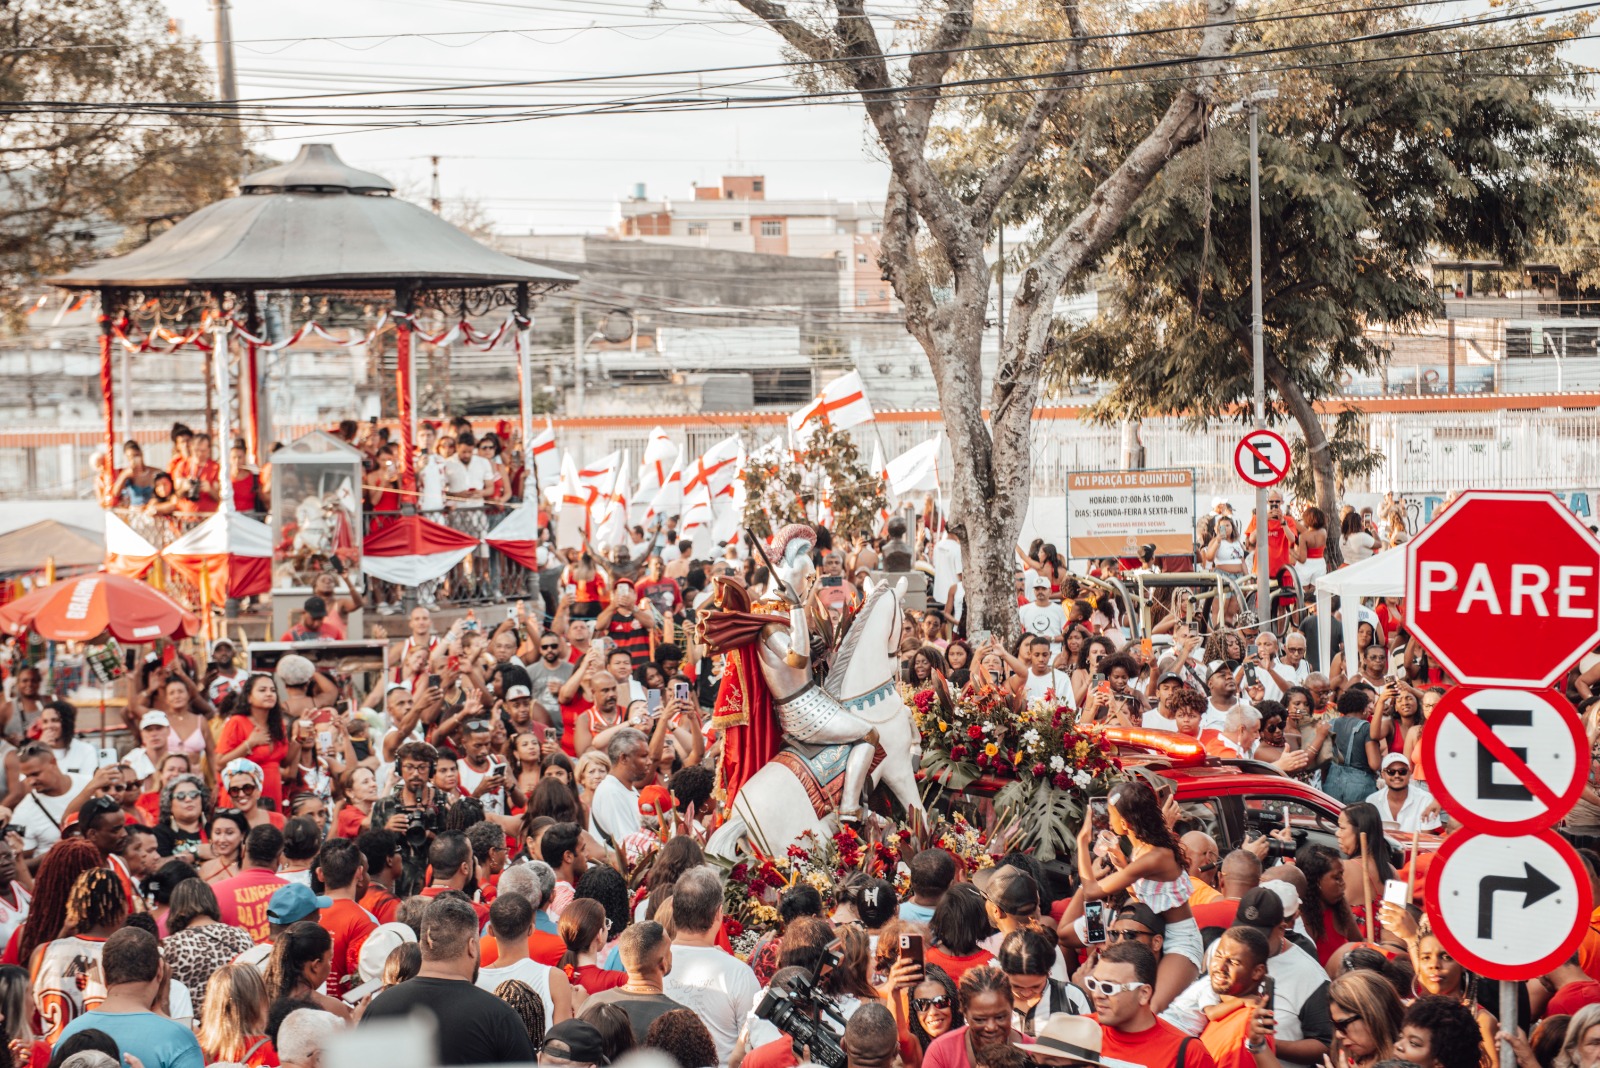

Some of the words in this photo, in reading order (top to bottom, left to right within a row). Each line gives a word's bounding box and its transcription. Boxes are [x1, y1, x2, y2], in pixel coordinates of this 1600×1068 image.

[1253, 443, 1273, 474] E
[1075, 476, 1089, 486] ATI
[1092, 474, 1122, 488] PRAÇA
[1125, 474, 1137, 485] DE
[1140, 473, 1186, 486] QUINTINO
[1090, 494, 1119, 504] HORÁRIO:
[1120, 496, 1141, 504] 07:00h
[1143, 493, 1150, 502] ÀS
[1153, 494, 1173, 502] 10:00h
[1093, 508, 1142, 517] SEGUNDA-FEIRA
[1149, 506, 1188, 515] SEXTA-FEIRA
[1419, 561, 1594, 618] PARE
[1477, 709, 1533, 801] E
[234, 884, 287, 903] KINGSL
[237, 905, 255, 927] DA
